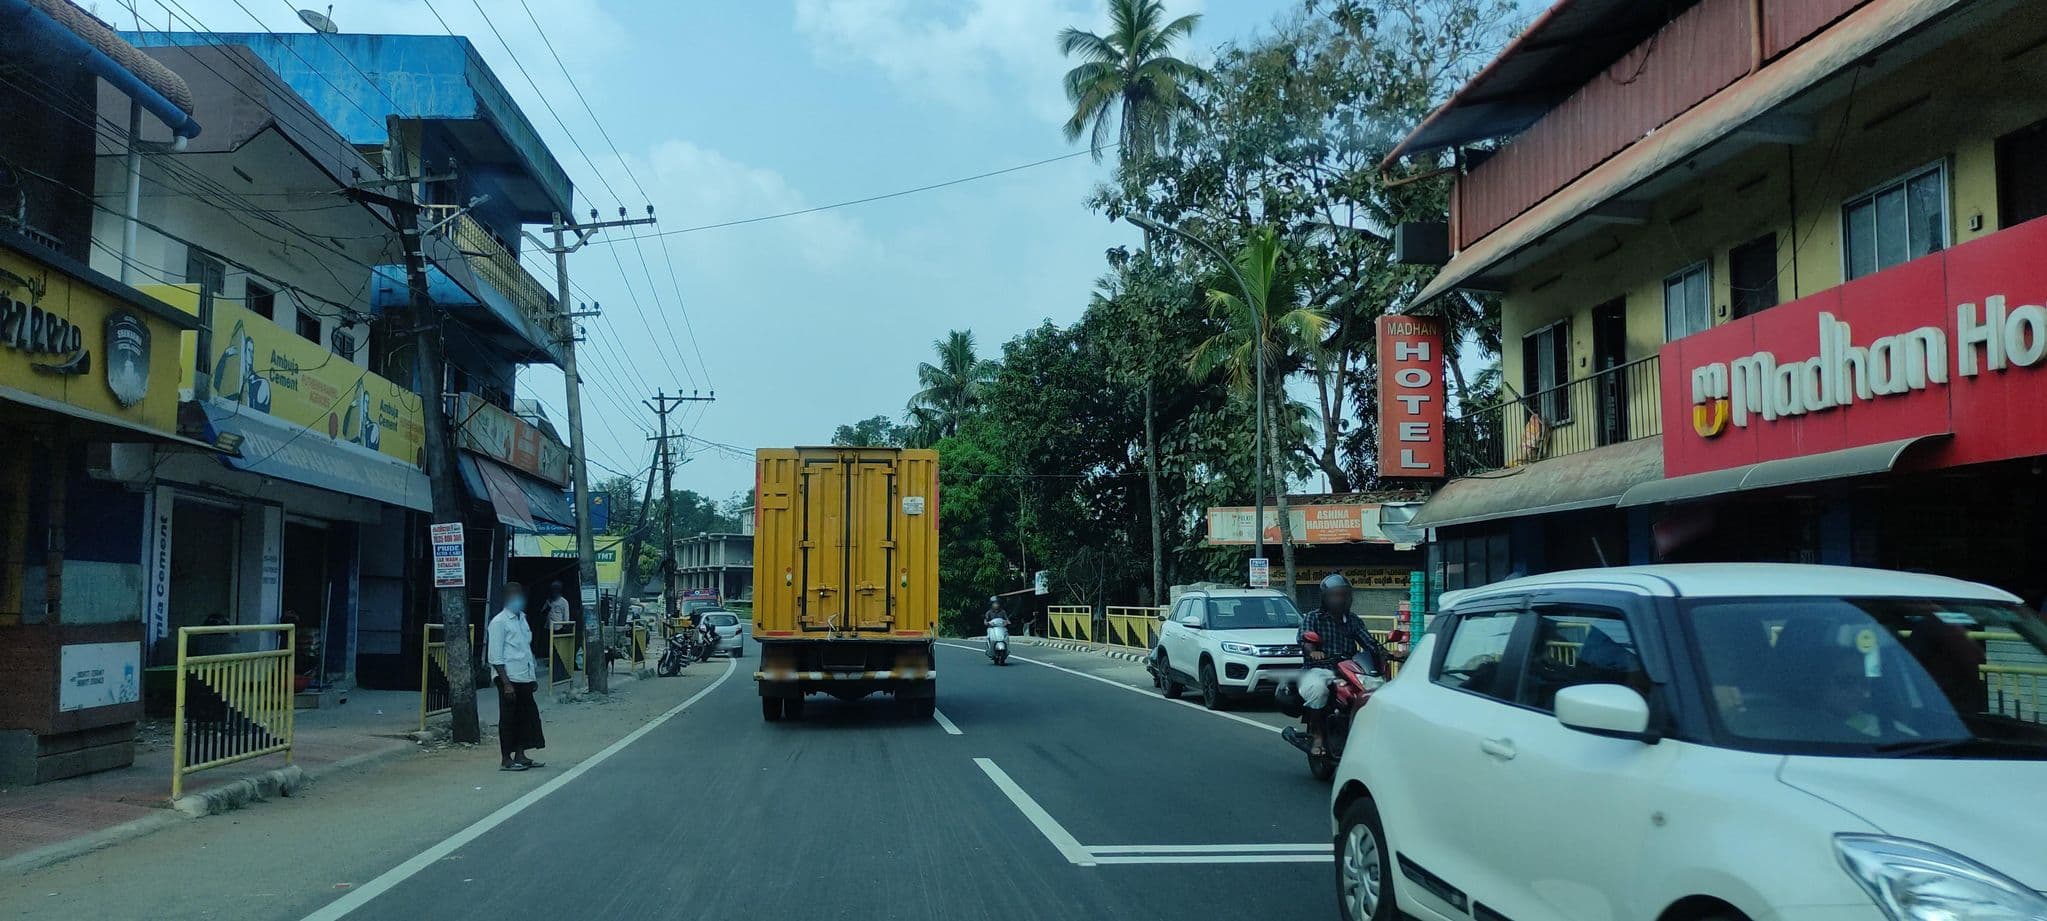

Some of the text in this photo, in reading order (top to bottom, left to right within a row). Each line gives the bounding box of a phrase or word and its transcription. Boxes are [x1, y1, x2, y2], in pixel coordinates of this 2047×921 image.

[1387, 321, 1438, 336] MADHAN
[270, 349, 299, 376] Ambuja
[1731, 311, 1948, 428] Madhan
[1957, 294, 2047, 377] Ho
[269, 367, 298, 392] Cement
[380, 399, 398, 420] Ambuja
[1394, 341, 1431, 469] HOTEL
[379, 413, 398, 433] Cement
[155, 515, 169, 597] Cement
[596, 552, 613, 560] TMT
